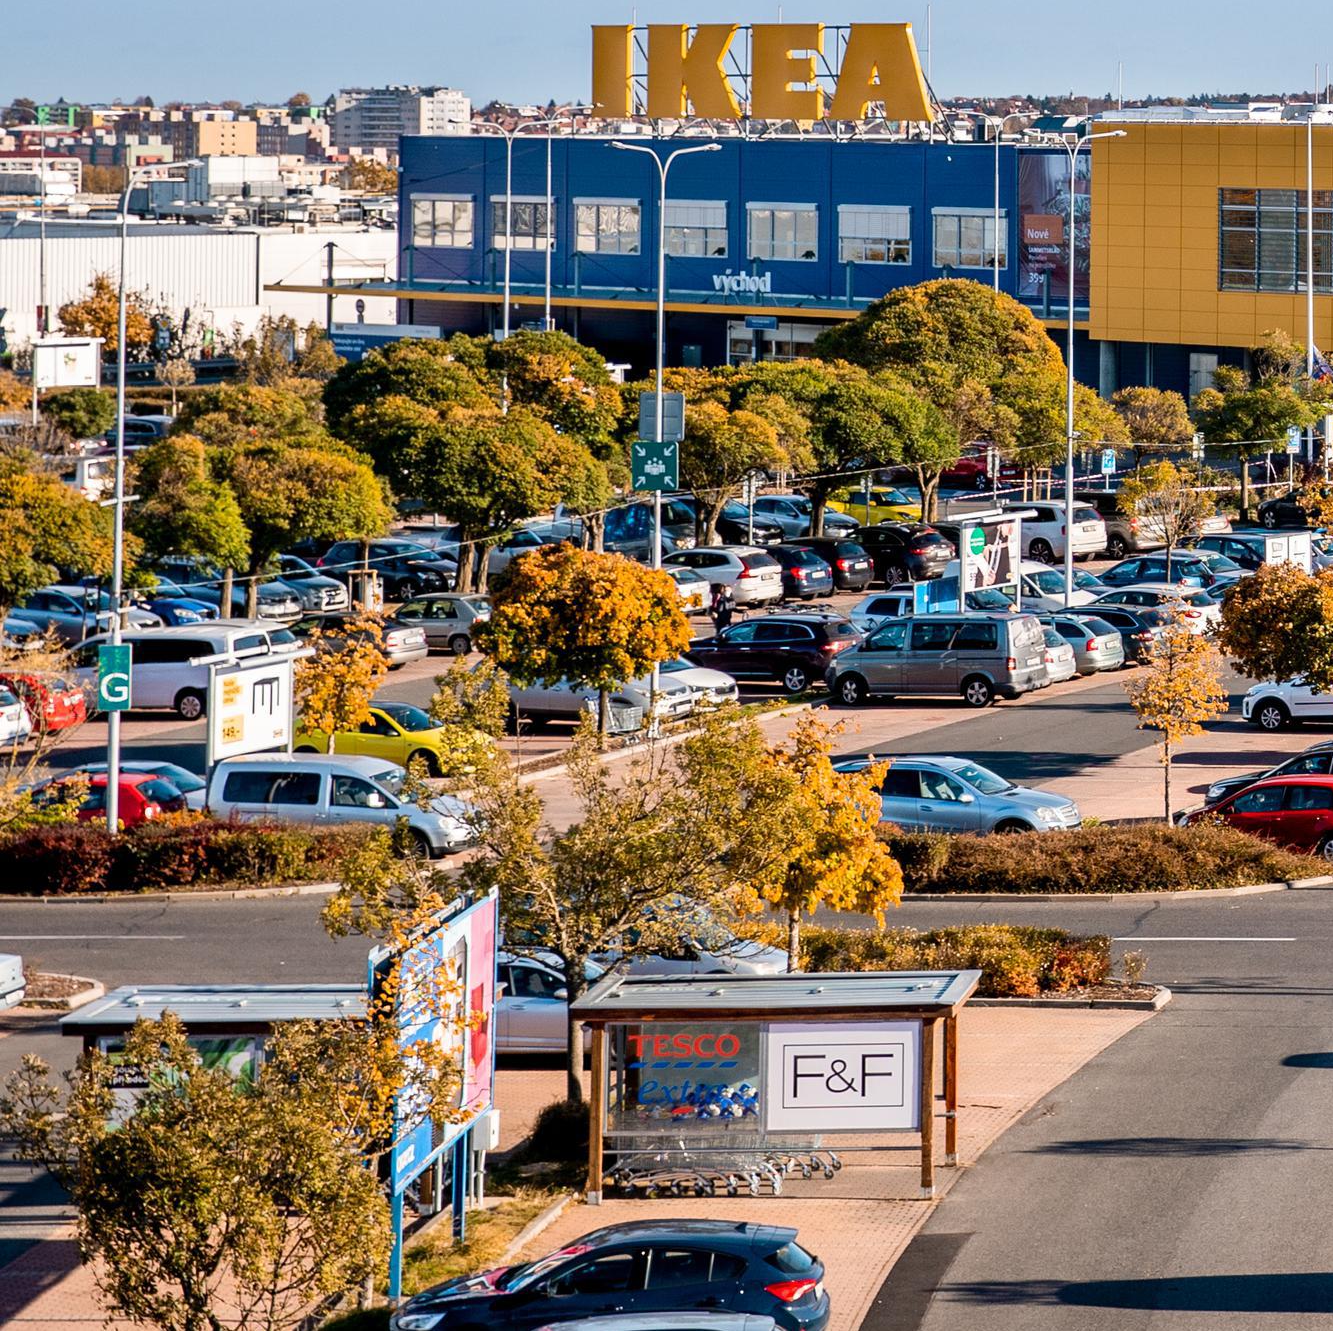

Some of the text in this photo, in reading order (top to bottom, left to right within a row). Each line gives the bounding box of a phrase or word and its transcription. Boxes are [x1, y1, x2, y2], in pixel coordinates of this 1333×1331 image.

[592, 23, 933, 121] IKEA
[1027, 228, 1049, 239] Nové
[712, 268, 771, 296] východ
[100, 672, 128, 702] G
[628, 1034, 741, 1058] TESCO
[793, 1053, 894, 1098] F&F
